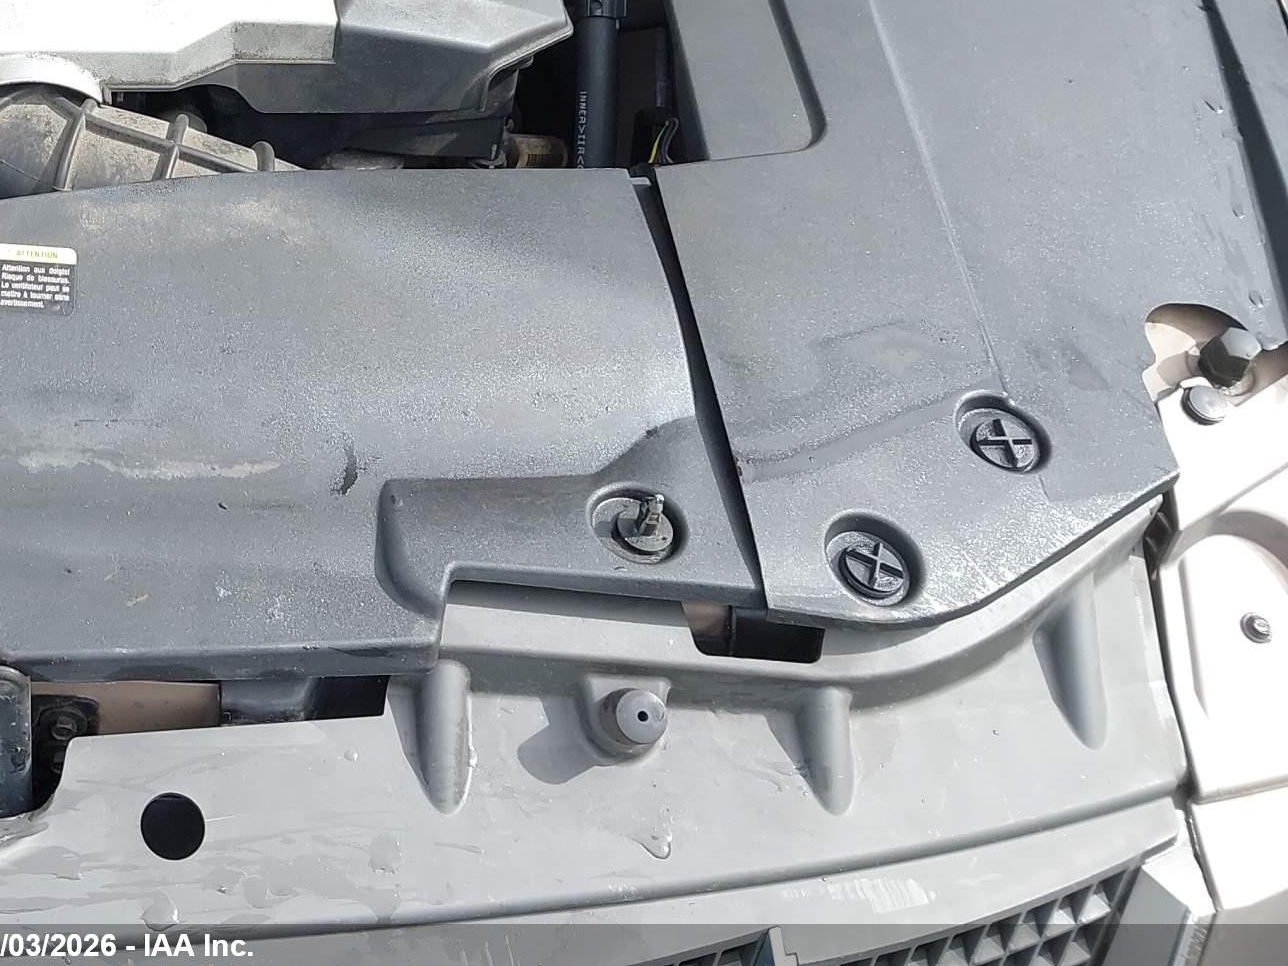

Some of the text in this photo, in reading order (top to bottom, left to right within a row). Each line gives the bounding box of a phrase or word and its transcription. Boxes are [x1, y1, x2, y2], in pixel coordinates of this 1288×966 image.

[16, 250, 58, 259] ATTENTION
[2, 264, 30, 273] Attention
[2, 272, 23, 281] Risque
[26, 273, 34, 281] de
[11, 282, 43, 291] ventilateur
[45, 284, 60, 292] peut
[1, 290, 21, 298] mettre
[30, 291, 52, 300] tourner
